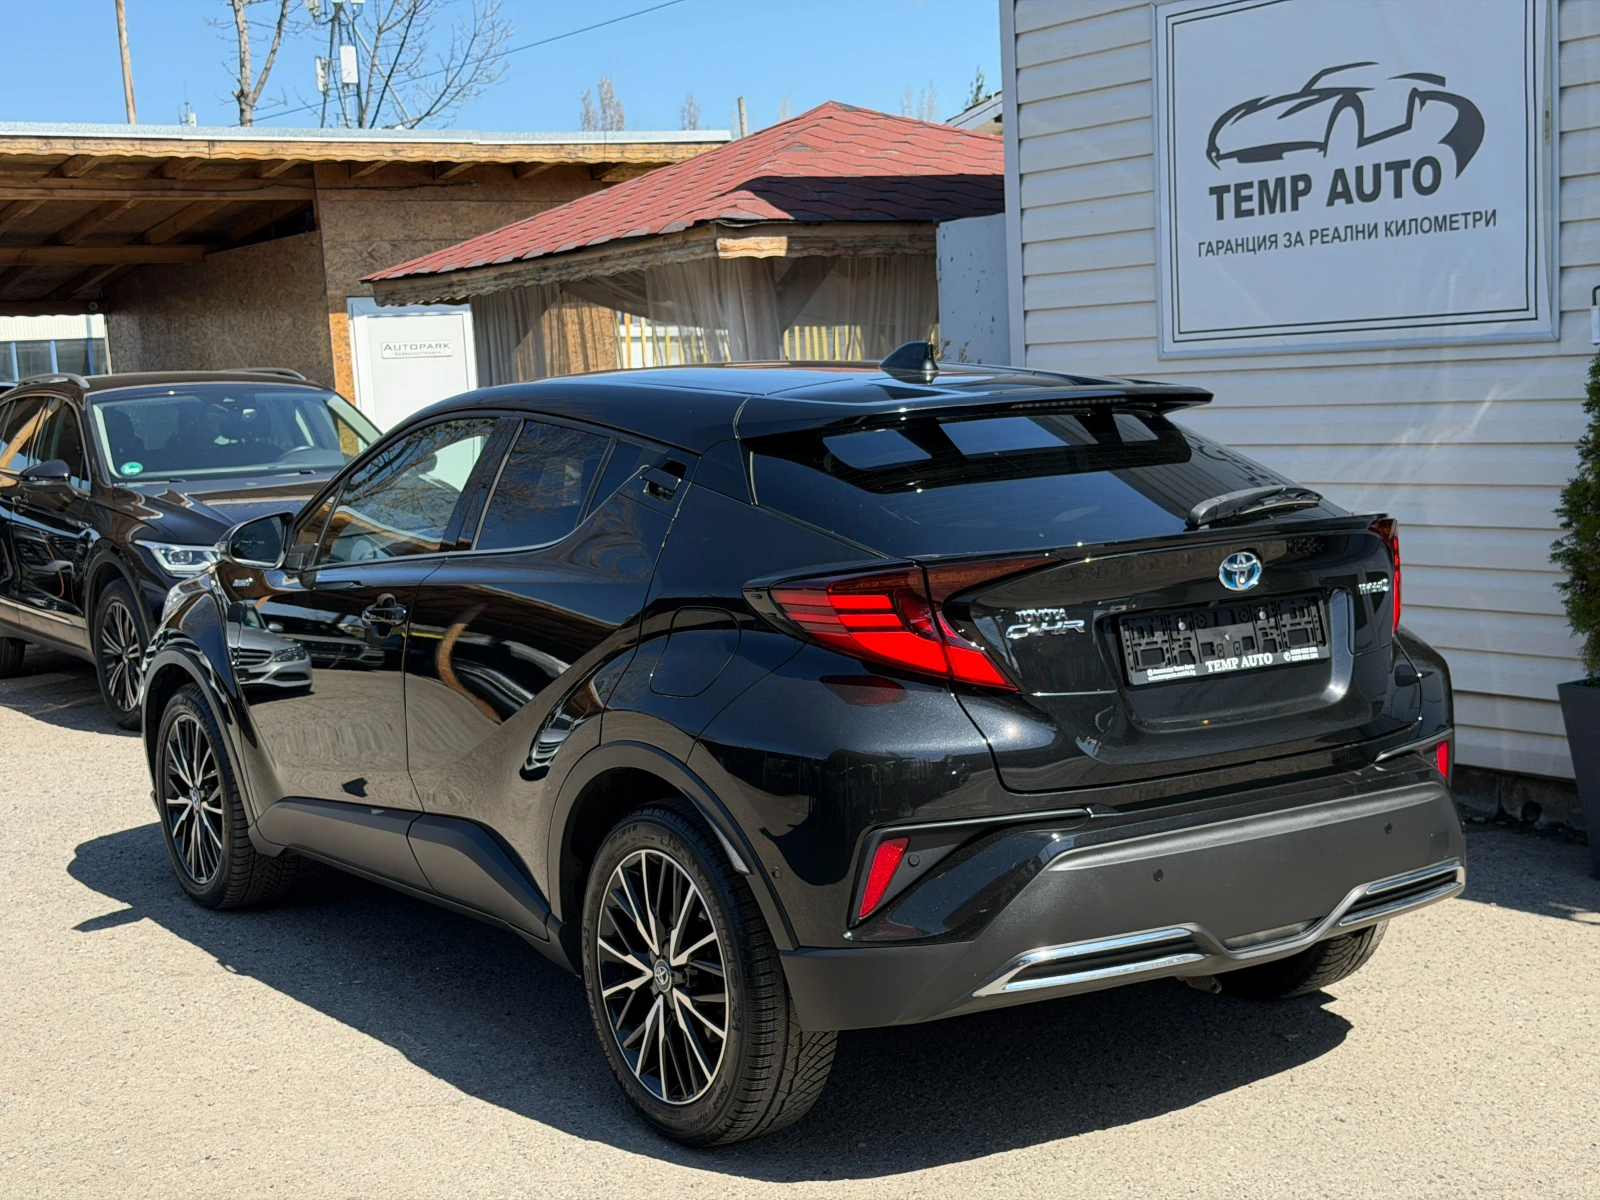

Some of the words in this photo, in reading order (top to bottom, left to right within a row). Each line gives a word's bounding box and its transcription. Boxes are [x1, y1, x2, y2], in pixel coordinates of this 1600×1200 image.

[1208, 173, 1313, 221] TEMP
[1325, 155, 1442, 208] AUTO
[1198, 233, 1278, 258] ГАРАНЦИЯ
[1283, 231, 1305, 249] ЗА
[1309, 222, 1379, 246] РЕАЛНИ
[1384, 208, 1497, 238] КИЛОМЕТРИ
[383, 342, 451, 352] AUTOPARK
[1015, 608, 1068, 623] TOYOTA
[1205, 657, 1240, 673] TEMP
[1241, 652, 1274, 669] AUTO
